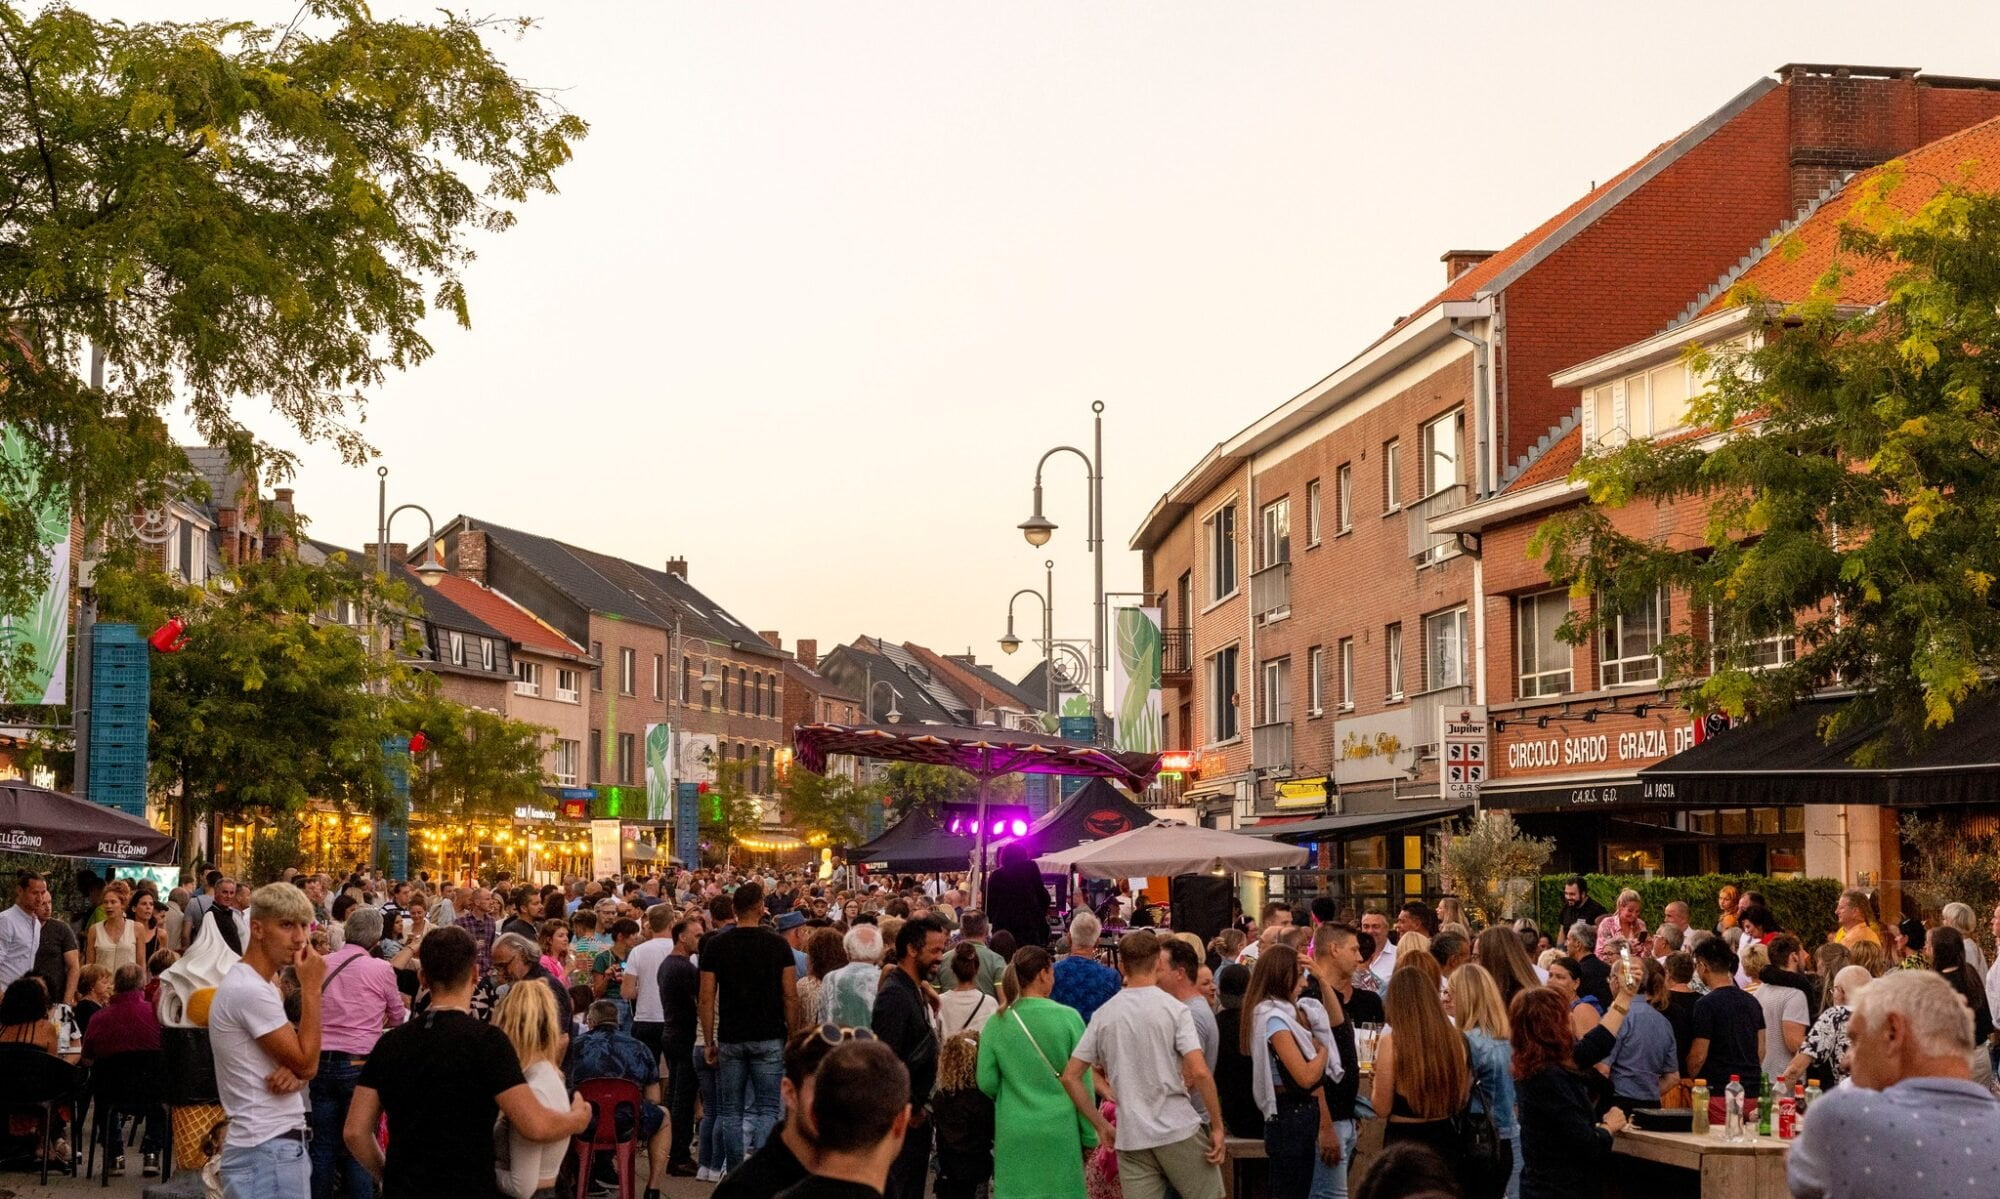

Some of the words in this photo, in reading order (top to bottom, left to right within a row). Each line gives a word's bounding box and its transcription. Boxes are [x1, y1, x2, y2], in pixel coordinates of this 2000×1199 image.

[1448, 724, 1484, 735] Jupiler
[1508, 740, 1558, 768] CIRCOLO
[1564, 735, 1608, 765] SARDO
[1619, 730, 1667, 760] GRAZIA
[1644, 784, 1653, 798] LA
[1655, 783, 1675, 798] POSTA
[98, 841, 148, 855] PELLEGRINO
